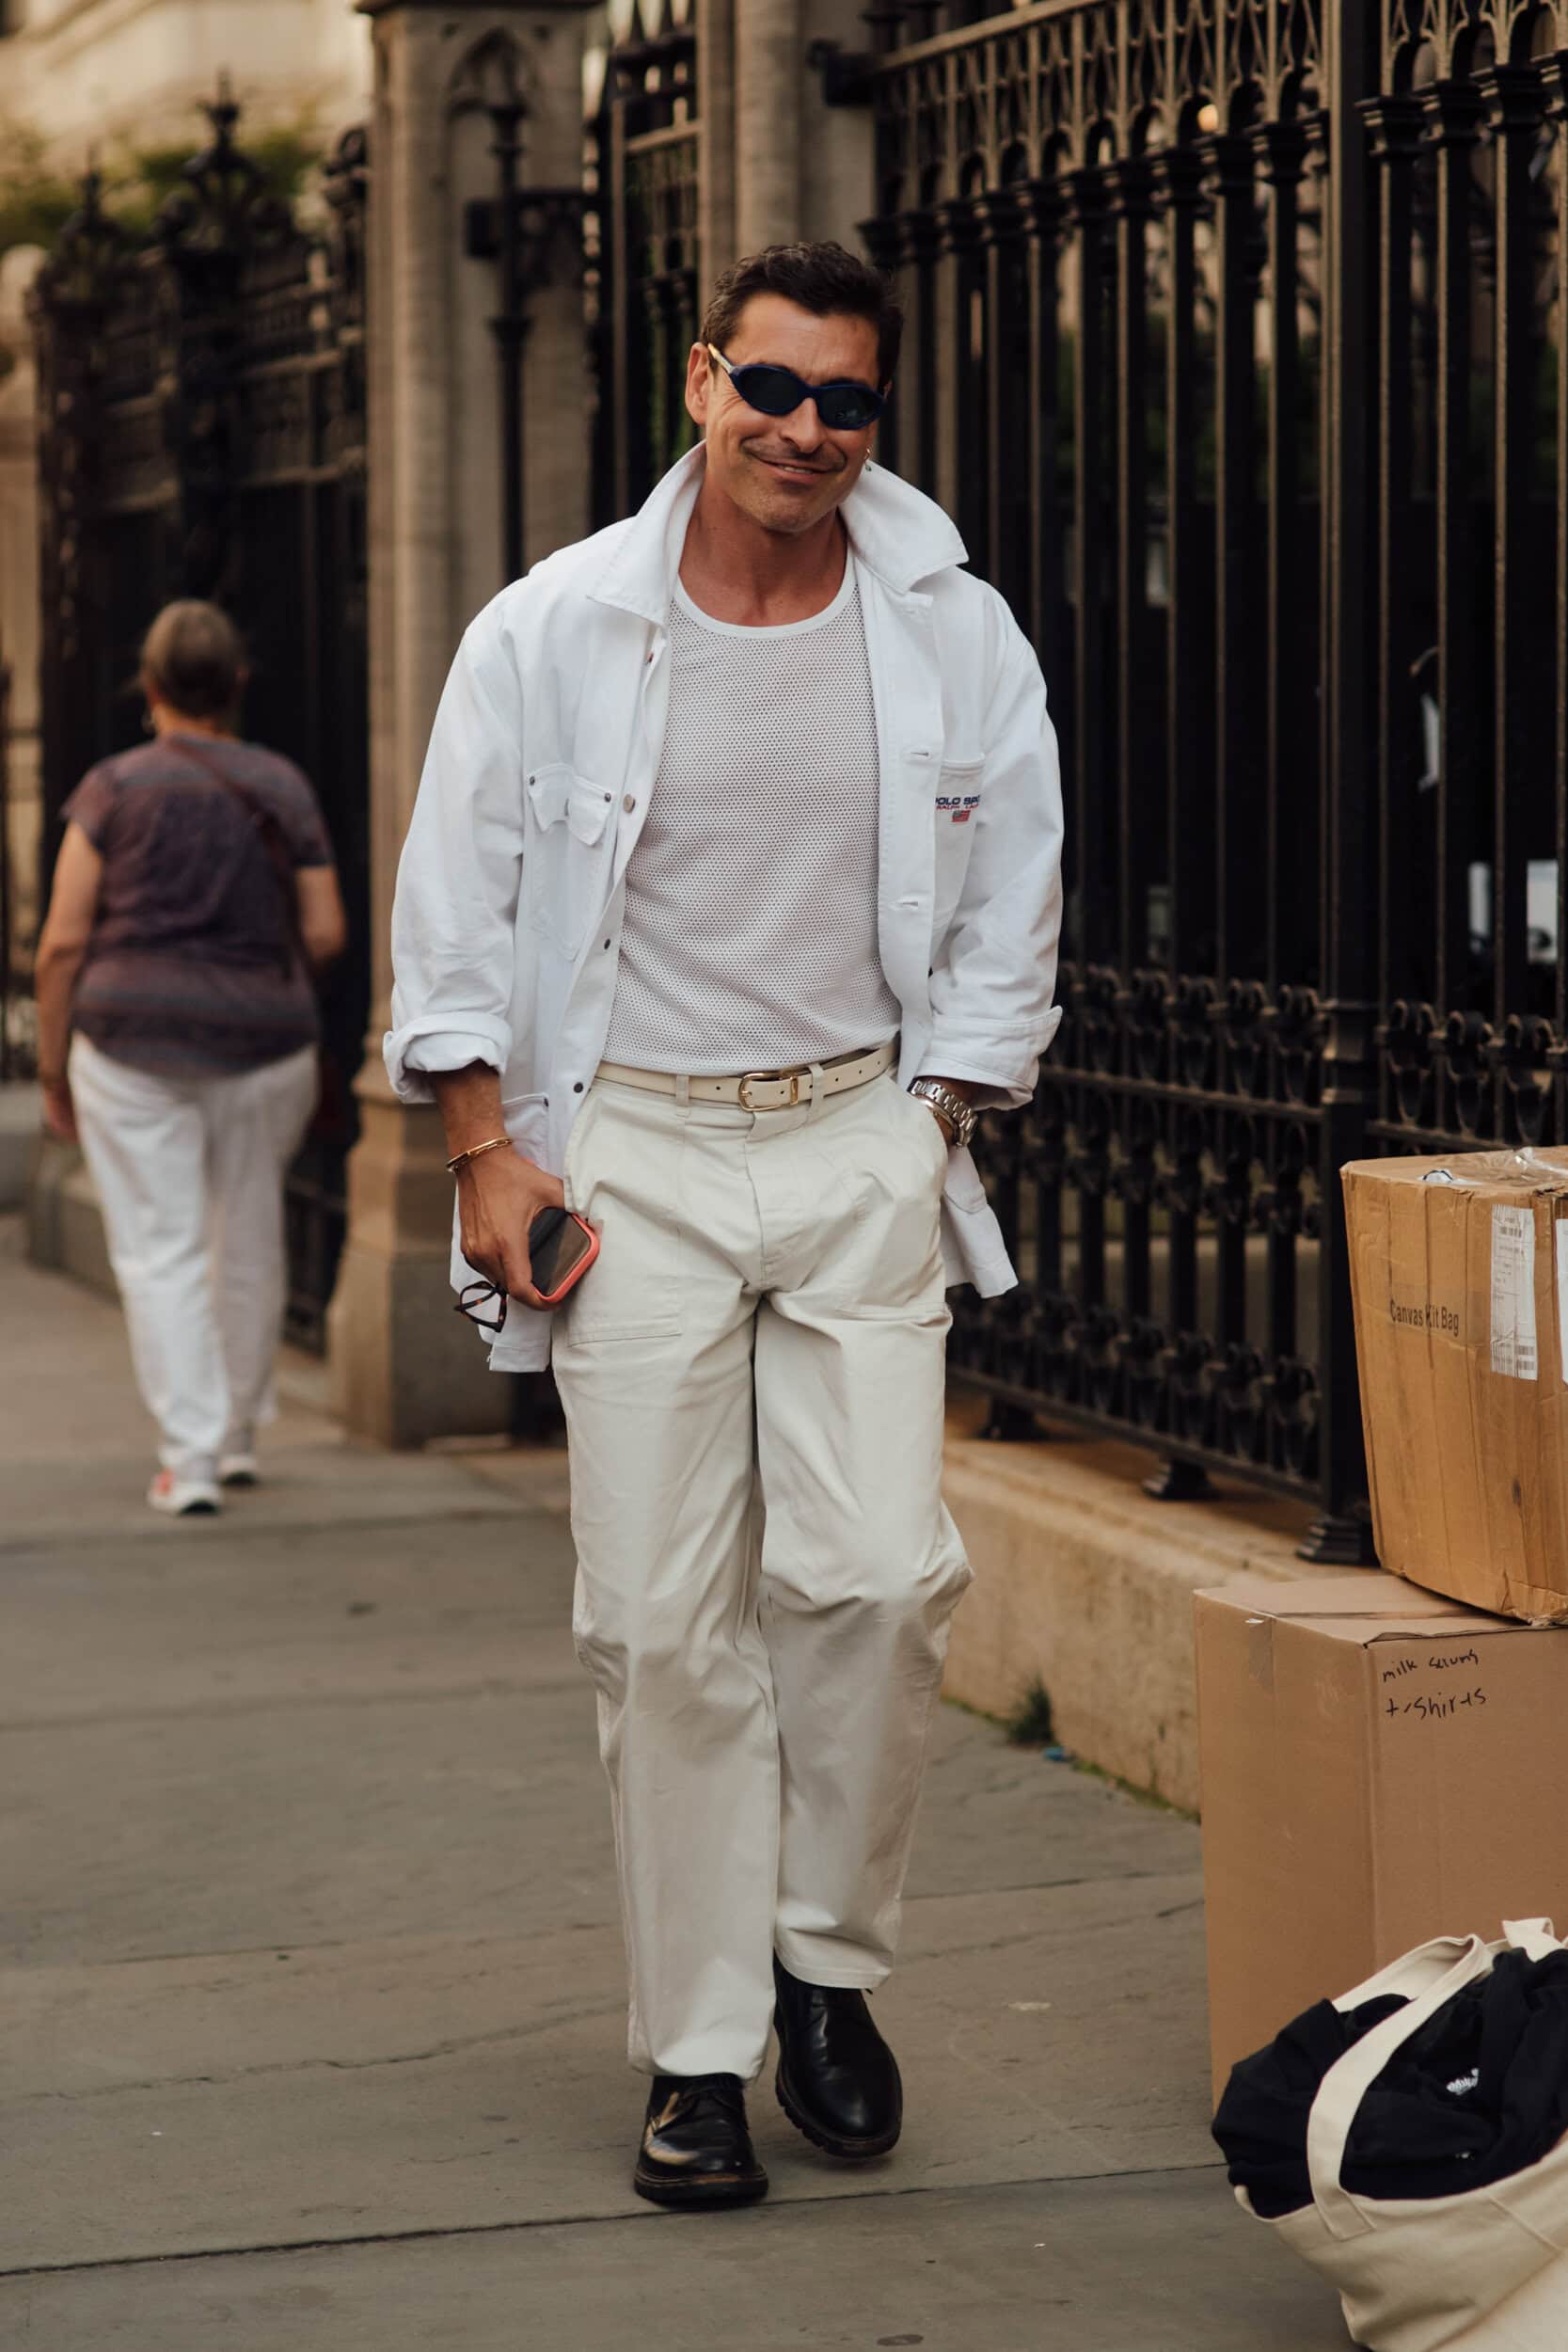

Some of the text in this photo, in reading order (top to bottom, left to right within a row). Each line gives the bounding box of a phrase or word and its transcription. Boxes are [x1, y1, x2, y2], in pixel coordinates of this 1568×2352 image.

[1390, 1299, 1422, 1327] Canvas
[1441, 1305, 1459, 1338] Bag
[1383, 1659, 1418, 1682] milk
